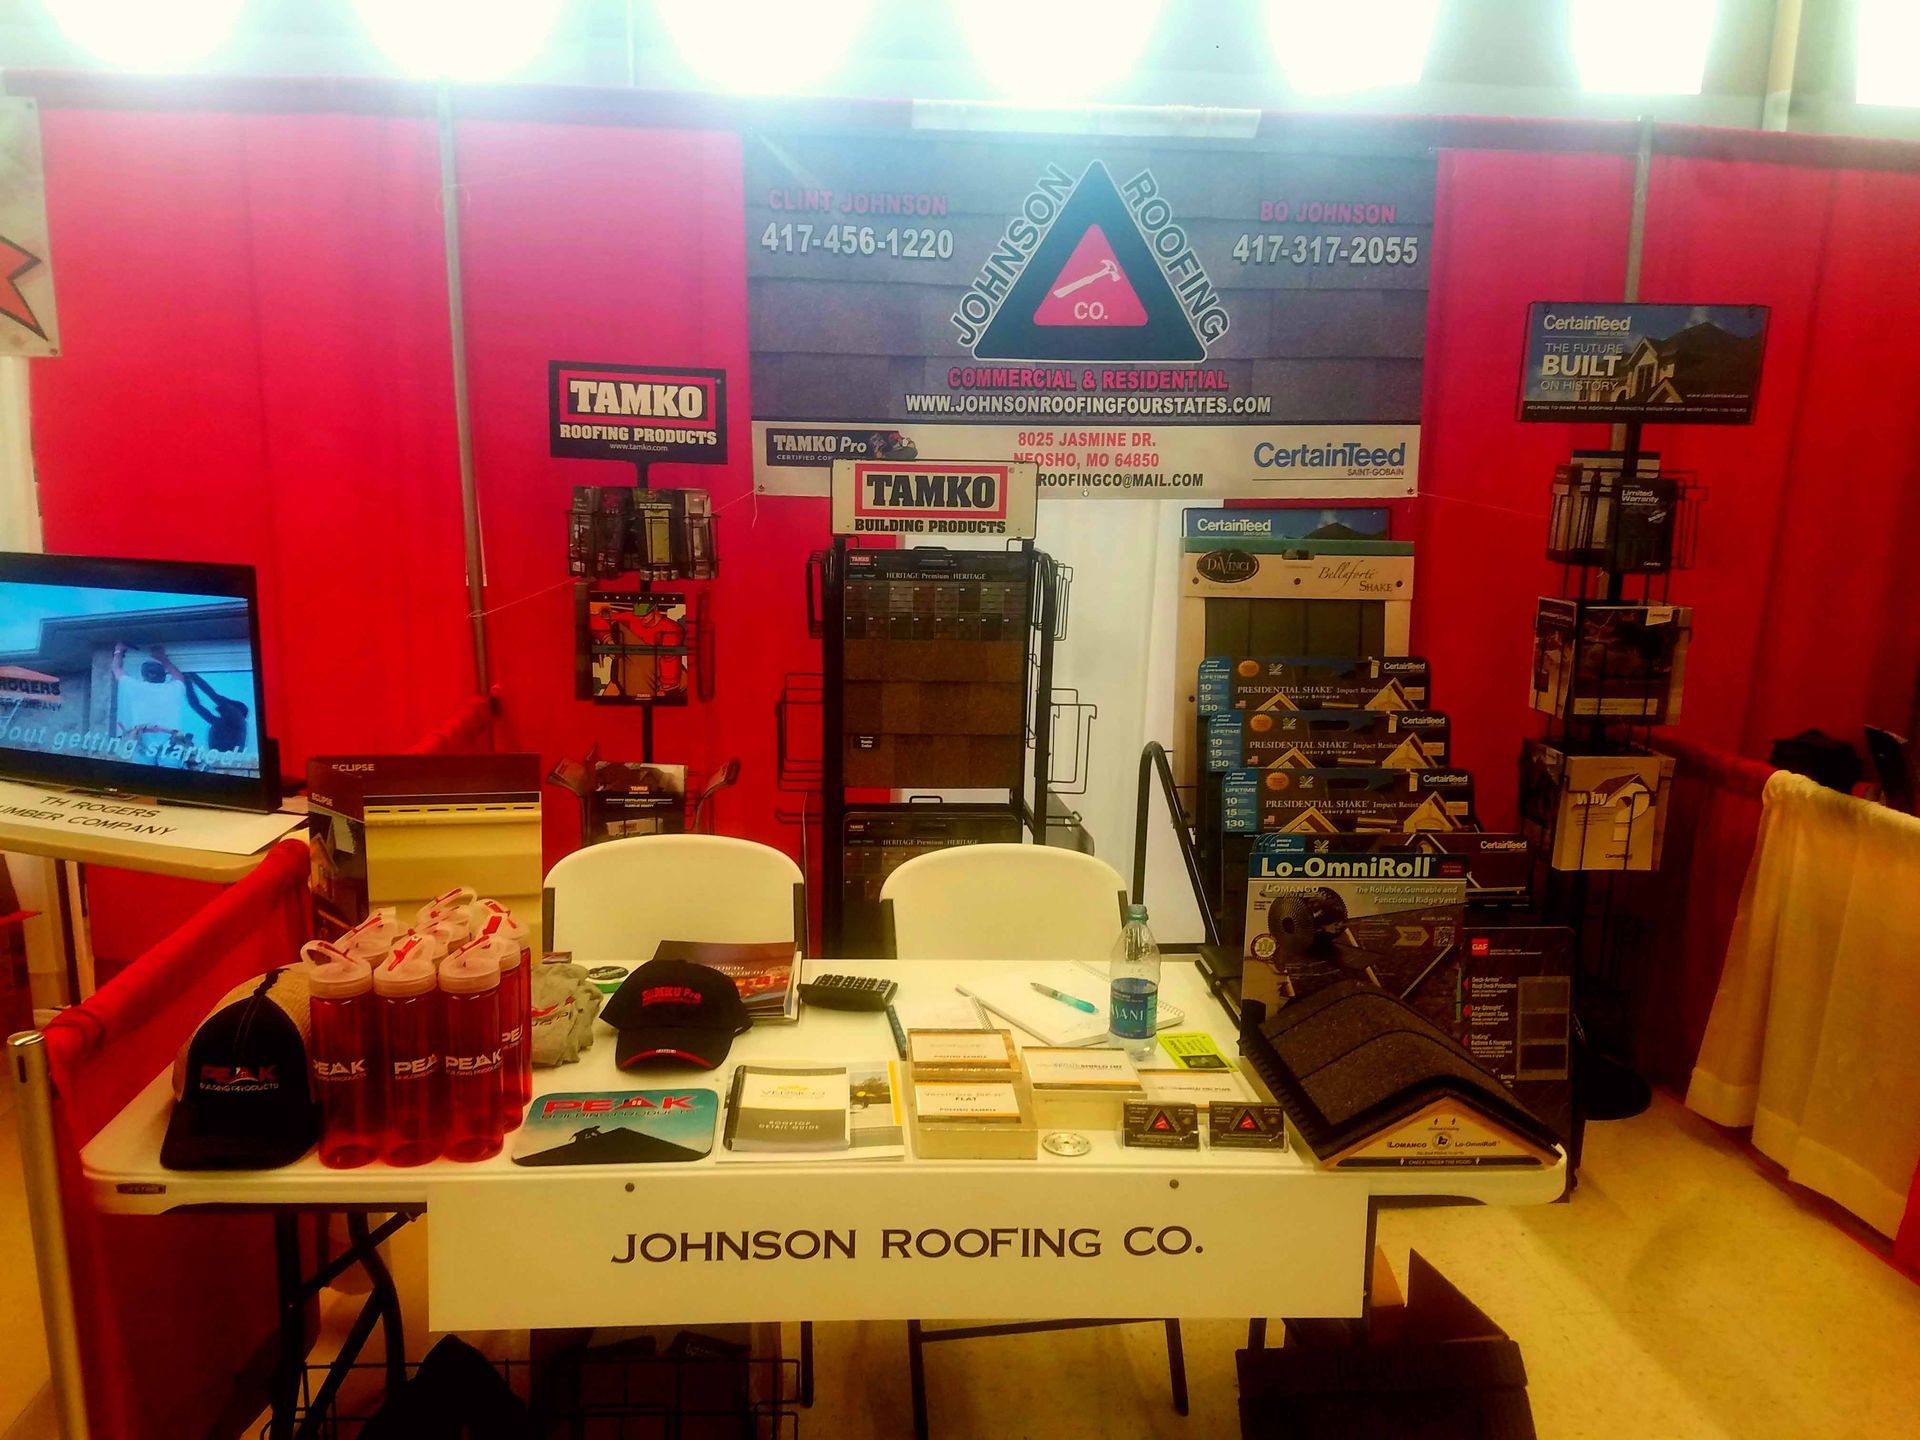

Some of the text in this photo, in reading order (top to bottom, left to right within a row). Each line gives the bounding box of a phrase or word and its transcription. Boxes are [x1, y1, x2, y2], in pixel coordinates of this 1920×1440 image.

[768, 188, 948, 216] CLINT JOHNSON
[1260, 200, 1396, 224] BO JOHNSON
[761, 222, 954, 259] 417-456-1220
[951, 162, 1076, 346] JOHNSON
[1121, 167, 1231, 346] ROOFING
[1233, 233, 1418, 265] 417-317-2055
[1073, 301, 1109, 321] CO.
[1543, 314, 1632, 332] CertainTeed
[1545, 342, 1623, 354] THE FUTURE
[1541, 354, 1622, 377] BUILT
[948, 368, 1229, 391] COMMERCIAL & RESIDENTIAL
[1541, 380, 1619, 392] ON HISTORY
[570, 380, 703, 418] TAMKO
[905, 394, 1272, 415] WWW.JOHNSONROOFINGFOURSTATES.COM
[559, 424, 718, 446] ROOFING PRODUCTS
[1018, 431, 1156, 447] 8025 JASMINE DR.
[609, 442, 669, 452] www.tamko.com
[773, 434, 868, 454] TAMKO Pro
[1086, 453, 1109, 468] MO
[1114, 453, 1159, 468] 64850
[1253, 441, 1406, 468] CertainTeed
[1347, 468, 1405, 476] SAINT-GOBAIN
[866, 474, 996, 509] TAMKO
[1622, 489, 1654, 497] Limited
[1621, 496, 1660, 504] Warranty
[854, 518, 1006, 534] BUILDING PRODUCTS
[1197, 518, 1272, 532] CertainTeed
[921, 572, 950, 580] Premium
[1358, 580, 1393, 593] SHAKE
[1237, 685, 1302, 694] PRESIDENTIAL
[1303, 686, 1332, 695] SHAKE
[1200, 704, 1218, 712] 130
[52, 729, 138, 760] getting
[145, 740, 248, 767] started!
[1249, 740, 1316, 750] PRESIDENTIAL
[1317, 741, 1348, 750] SHAKE
[332, 763, 375, 772] ECLIPSE
[40, 796, 162, 818] TH ROGERS
[1225, 797, 1238, 805] 10
[1265, 799, 1334, 809] PRESIDENTIAL
[1336, 799, 1367, 809] SHAKE
[1225, 808, 1238, 816] 15
[67, 815, 179, 836] COMPANY
[1225, 819, 1245, 828] 130
[1480, 840, 1527, 850] CertainTeed
[1260, 856, 1431, 878] Lo-OmniRoll
[1355, 886, 1369, 894] The
[1369, 886, 1404, 895] Rollable,
[1441, 886, 1458, 894] and
[1374, 896, 1458, 905] Functional Ridge Vent
[1472, 943, 1488, 951] GAF
[445, 1048, 503, 1071] PEAK
[200, 1061, 281, 1083] PEAK
[230, 1082, 280, 1093] PRODUCTS
[542, 1096, 700, 1114] PEAK
[1388, 1141, 1428, 1149] LOMANCO
[610, 1225, 1204, 1265] JOHNSON ROOFING CO.
